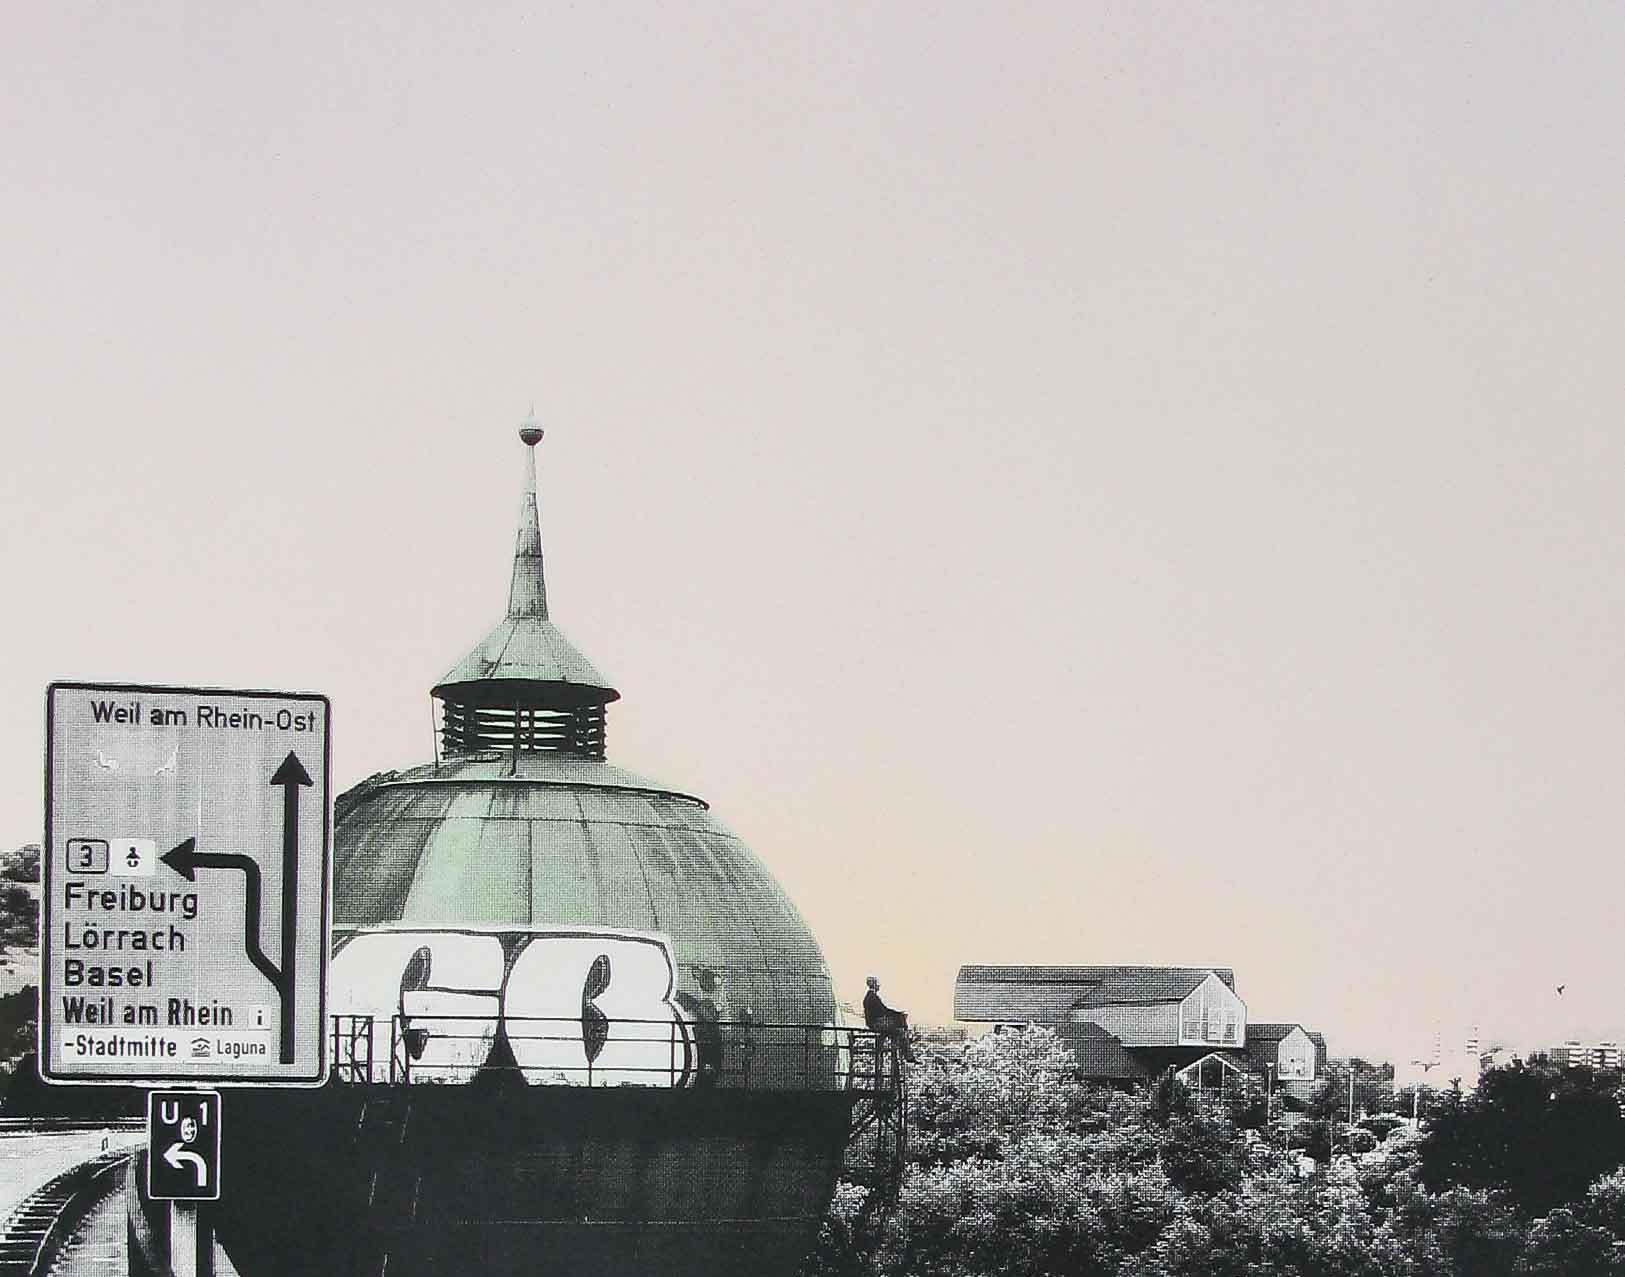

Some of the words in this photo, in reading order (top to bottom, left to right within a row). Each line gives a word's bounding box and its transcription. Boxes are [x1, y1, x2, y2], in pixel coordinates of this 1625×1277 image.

[91, 700, 141, 724] Weil
[150, 708, 187, 726] am
[197, 706, 316, 732] Rhein-Ost
[80, 844, 93, 867] 3
[64, 882, 198, 920] Freiburg
[64, 921, 185, 951] Lörrach
[64, 959, 153, 987] Basel
[62, 996, 114, 1025] Weil
[124, 1003, 158, 1026] am
[168, 998, 233, 1026] Rhein
[216, 1040, 266, 1059] Laguna
[161, 1101, 179, 1124] U
[199, 1101, 208, 1126] 1
